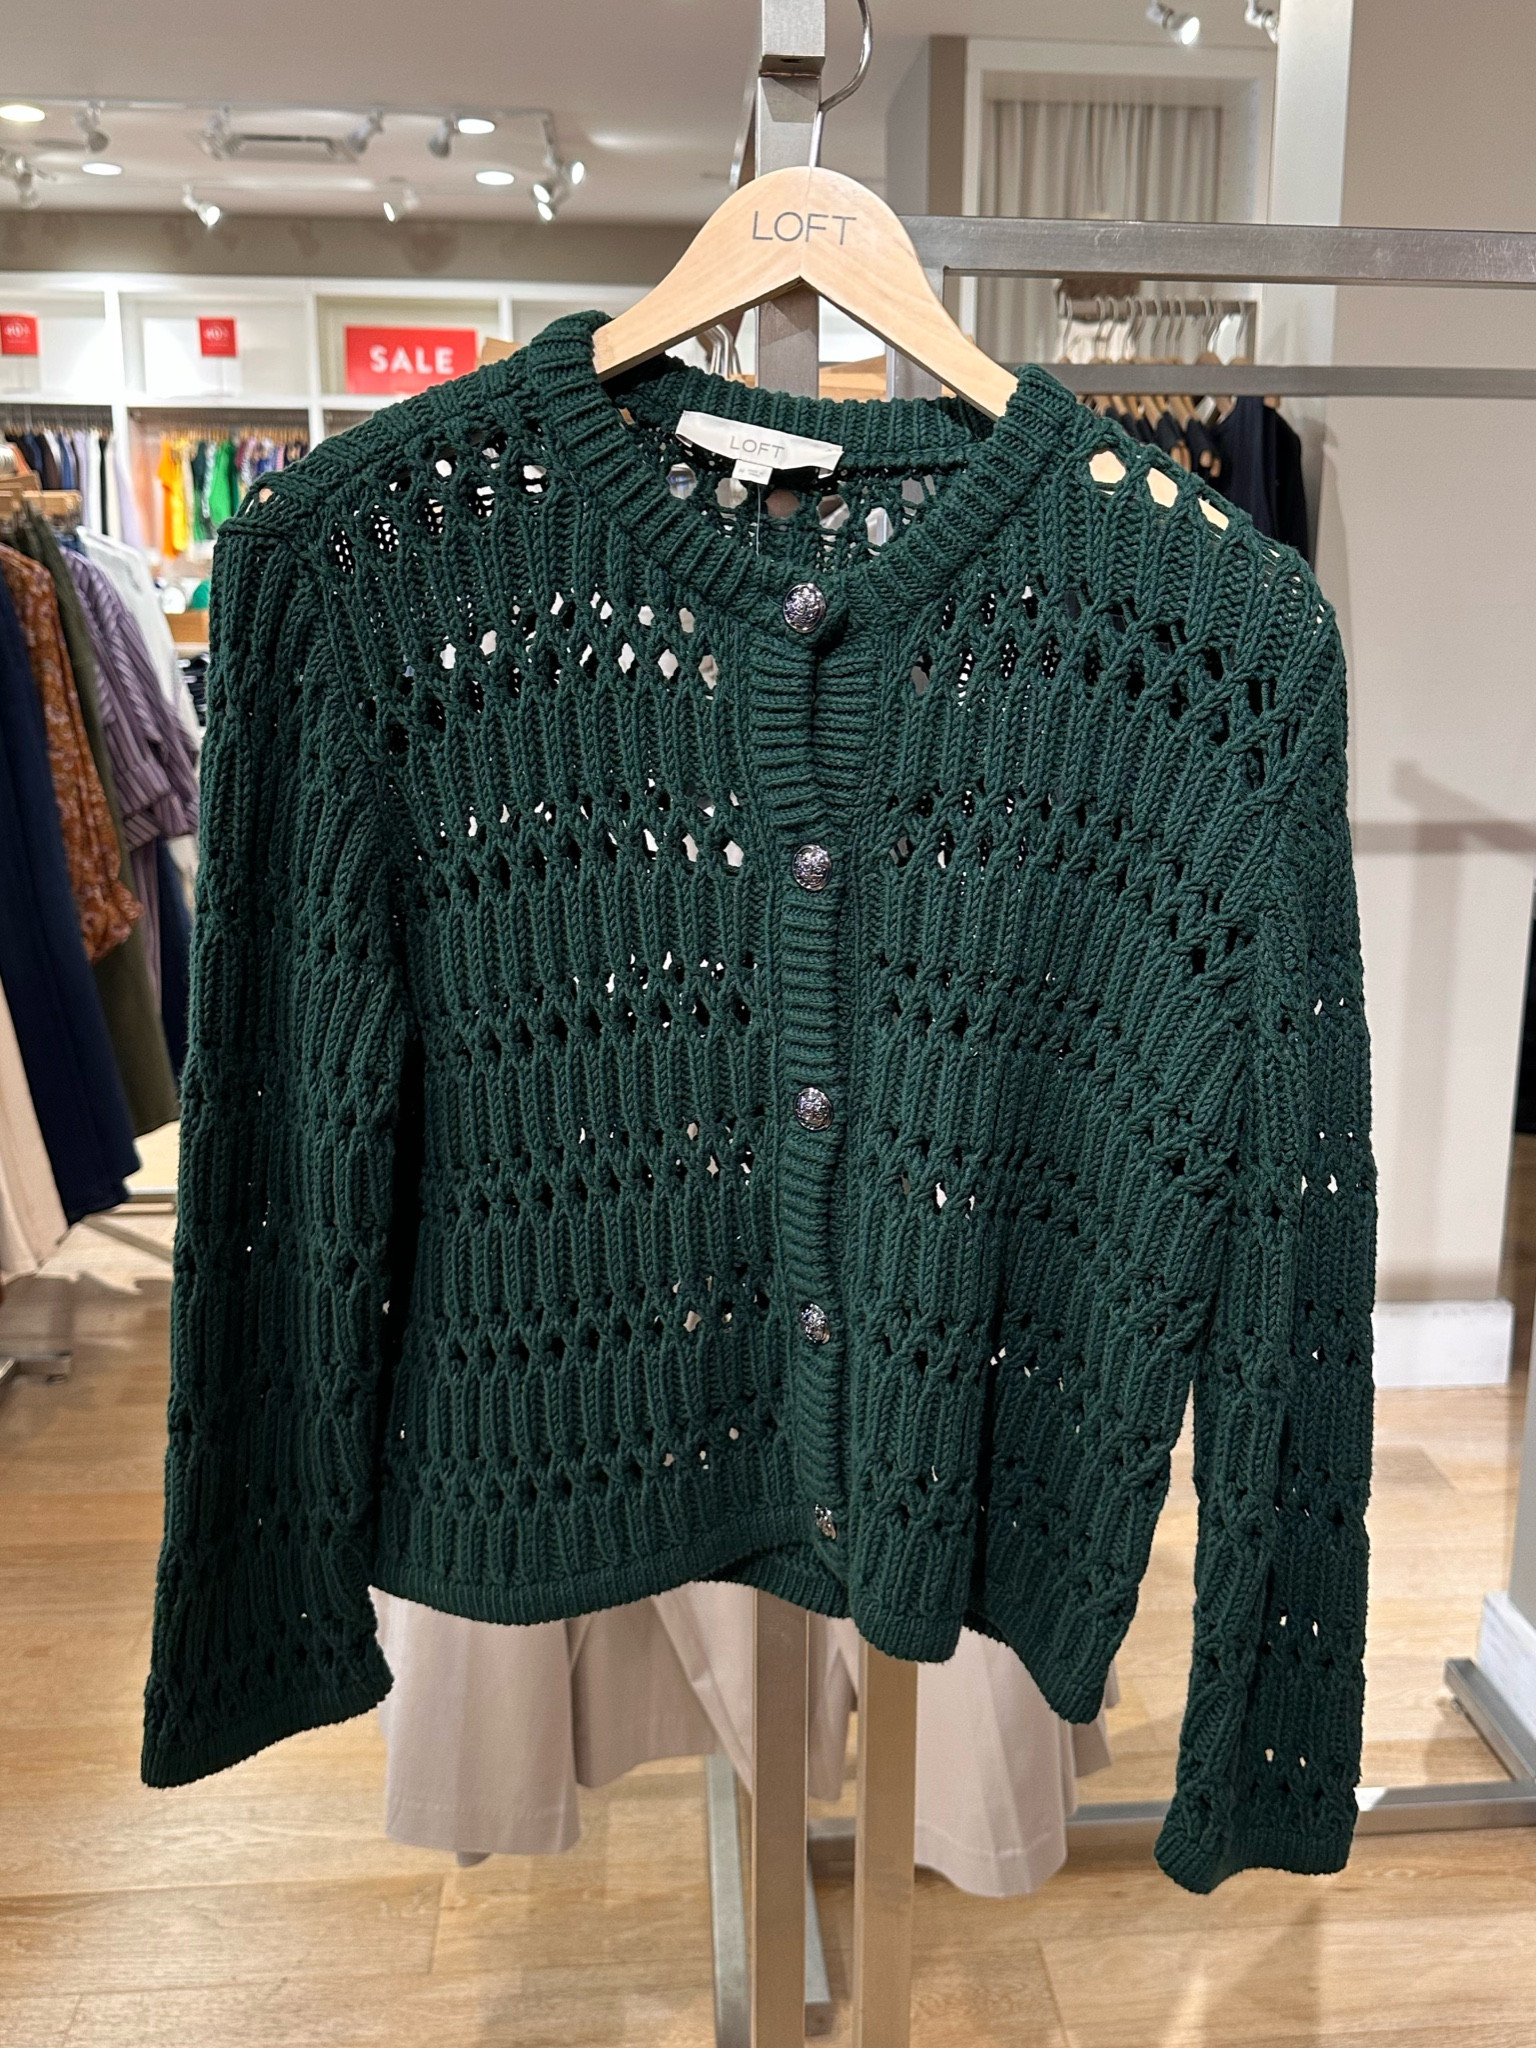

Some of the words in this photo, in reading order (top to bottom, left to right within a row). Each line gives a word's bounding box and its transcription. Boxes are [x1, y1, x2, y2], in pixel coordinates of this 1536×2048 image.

[752, 210, 857, 246] LOFT
[369, 344, 454, 375] SALE
[729, 435, 785, 459] LOFT
